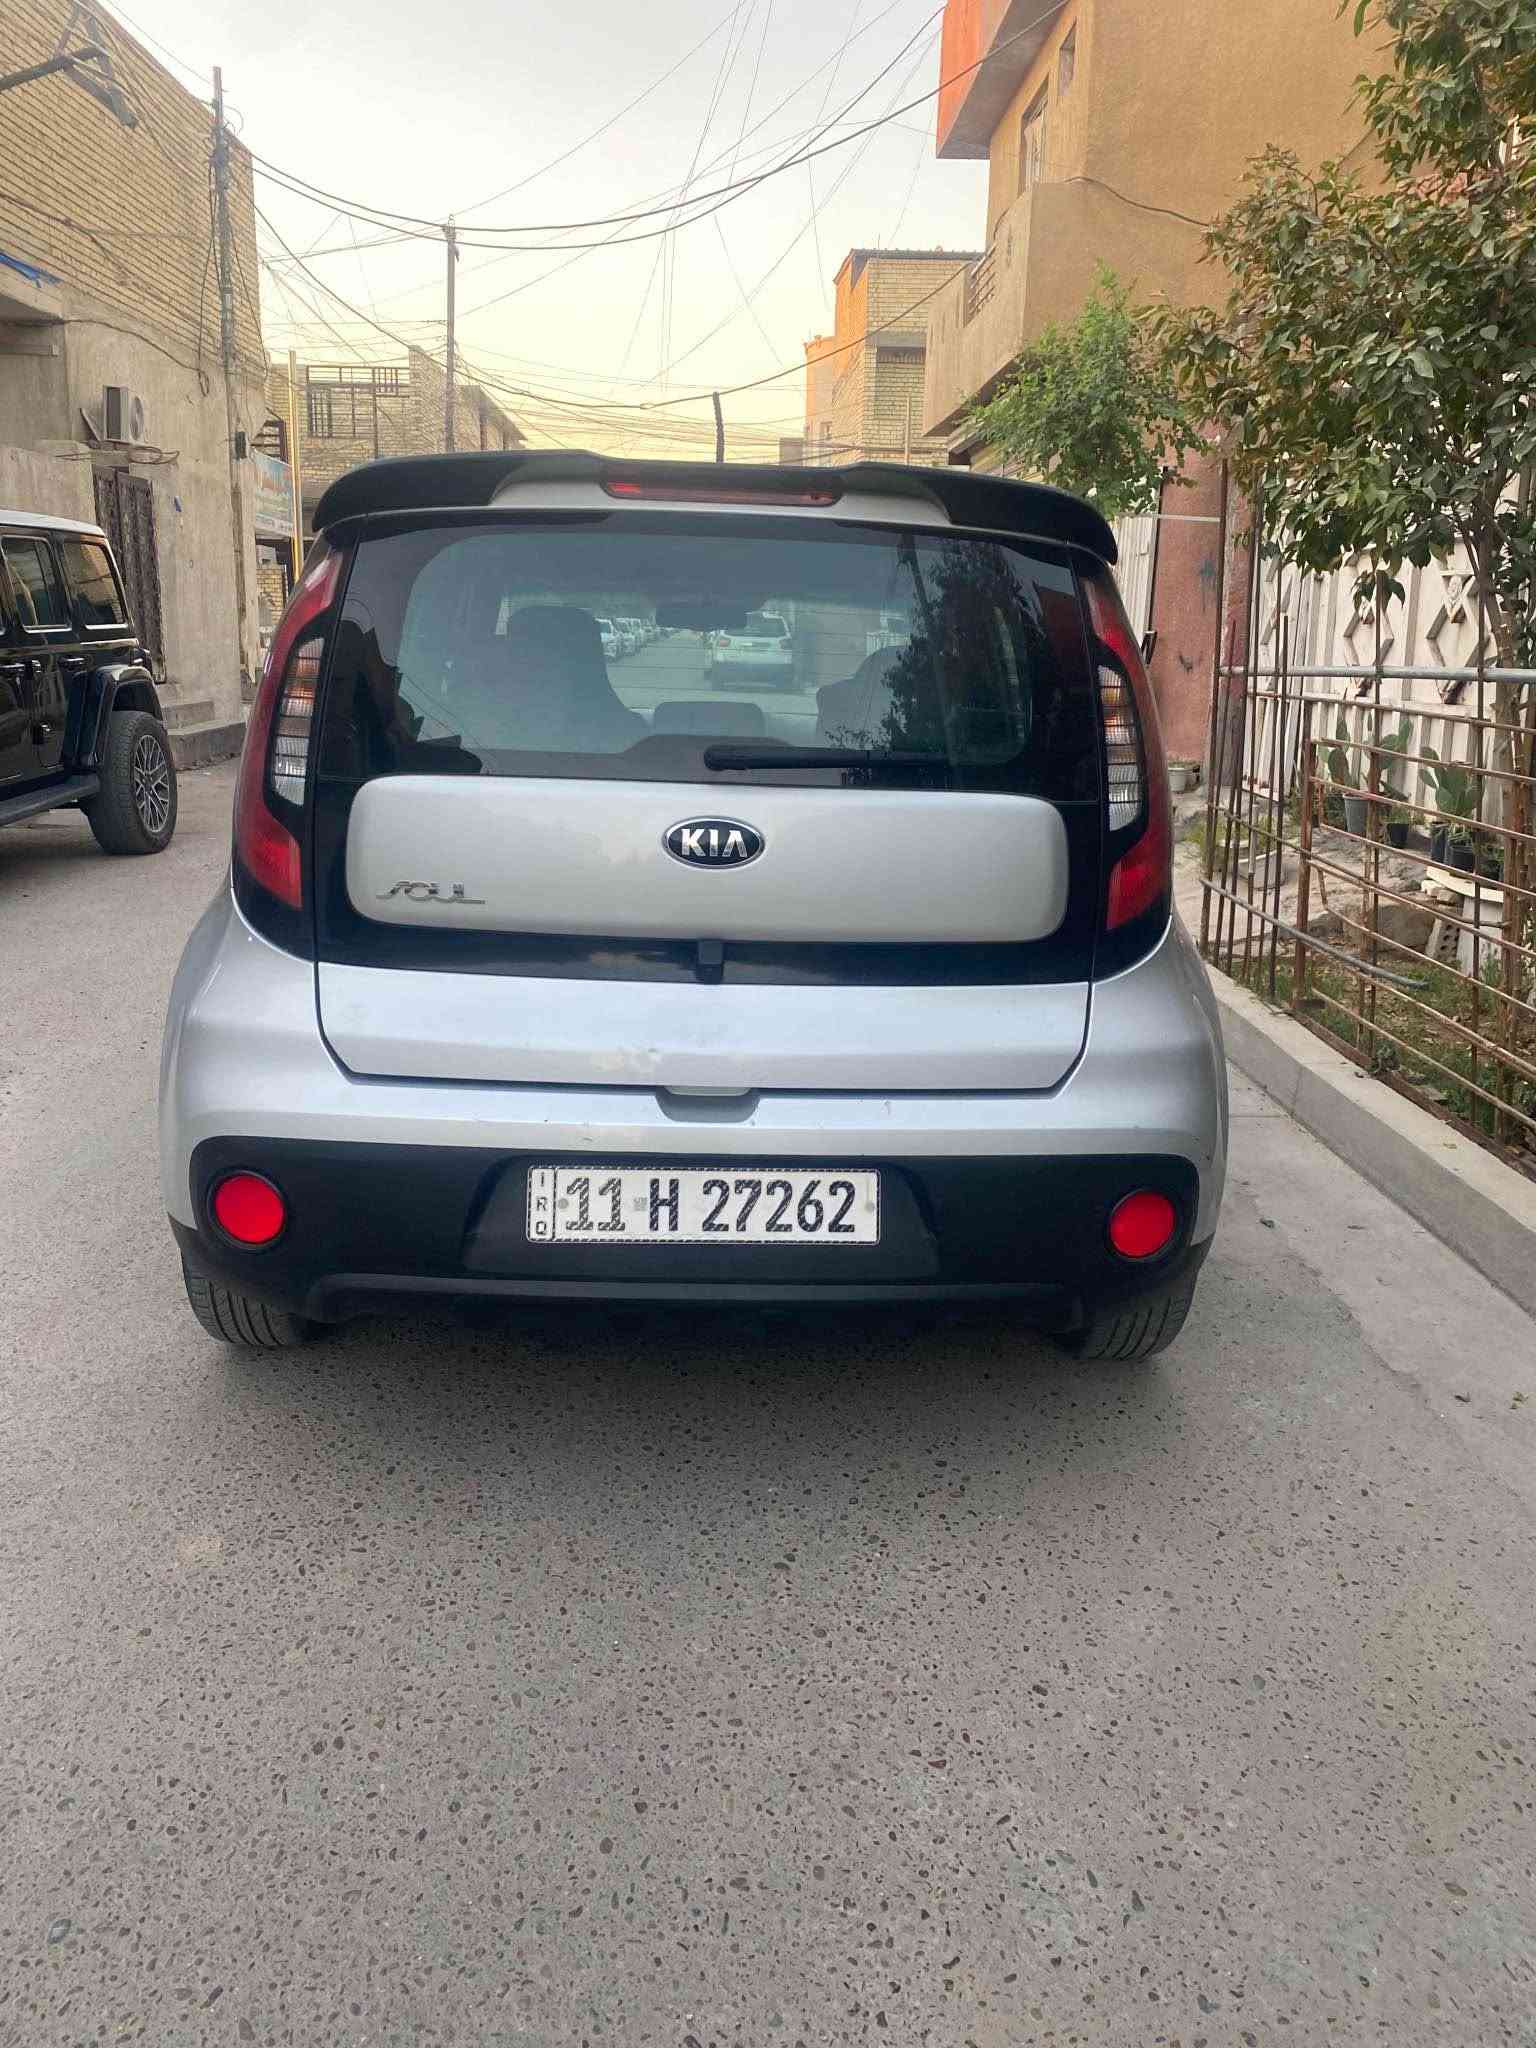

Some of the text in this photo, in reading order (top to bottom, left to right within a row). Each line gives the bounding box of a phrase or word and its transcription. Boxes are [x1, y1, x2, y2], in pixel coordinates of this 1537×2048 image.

[681, 828, 748, 857] KIA
[375, 880, 486, 905] SOUL
[535, 1171, 547, 1235] IRQ
[566, 1177, 856, 1233] 11 H 27262
